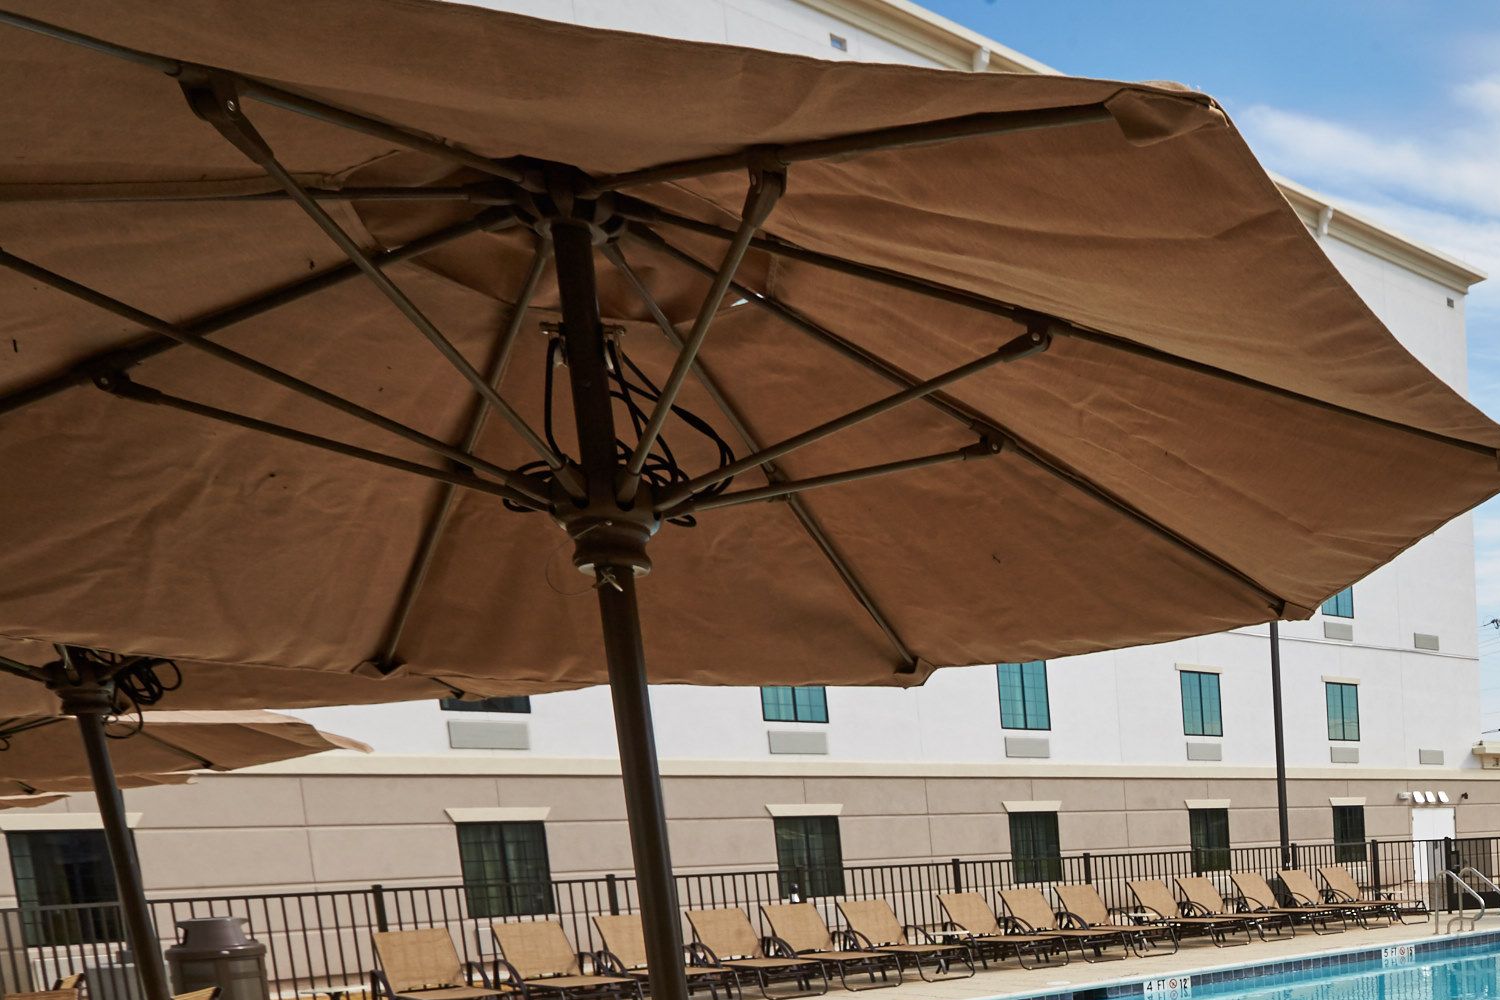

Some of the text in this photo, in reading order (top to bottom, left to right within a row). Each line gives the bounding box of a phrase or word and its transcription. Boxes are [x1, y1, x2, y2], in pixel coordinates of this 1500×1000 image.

[1383, 948, 1389, 958] 5
[1147, 981, 1153, 991] 4
[1157, 979, 1166, 991] FT
